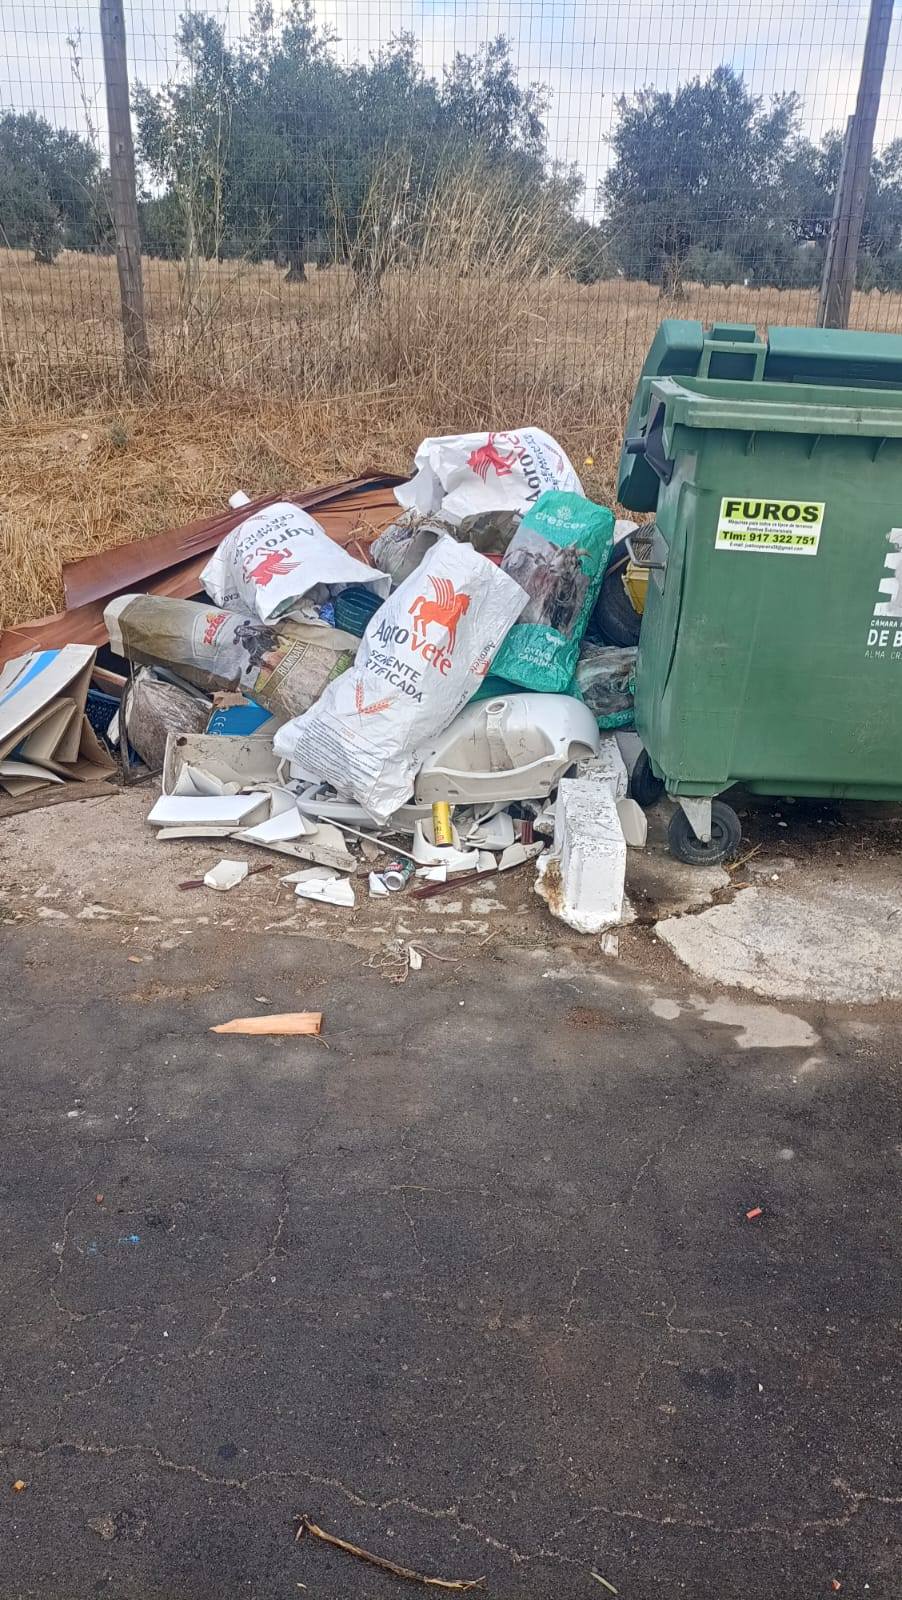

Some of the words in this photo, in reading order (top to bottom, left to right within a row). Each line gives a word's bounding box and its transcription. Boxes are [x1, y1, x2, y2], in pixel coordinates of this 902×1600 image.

[725, 501, 819, 522] FUROS
[722, 531, 746, 541] Tlm:
[749, 532, 769, 542] 917
[772, 534, 792, 543] 322
[796, 535, 815, 545] 751
[867, 629, 890, 647] DE
[369, 649, 422, 684] SEMENTE
[365, 658, 423, 704] RTIFICADA
